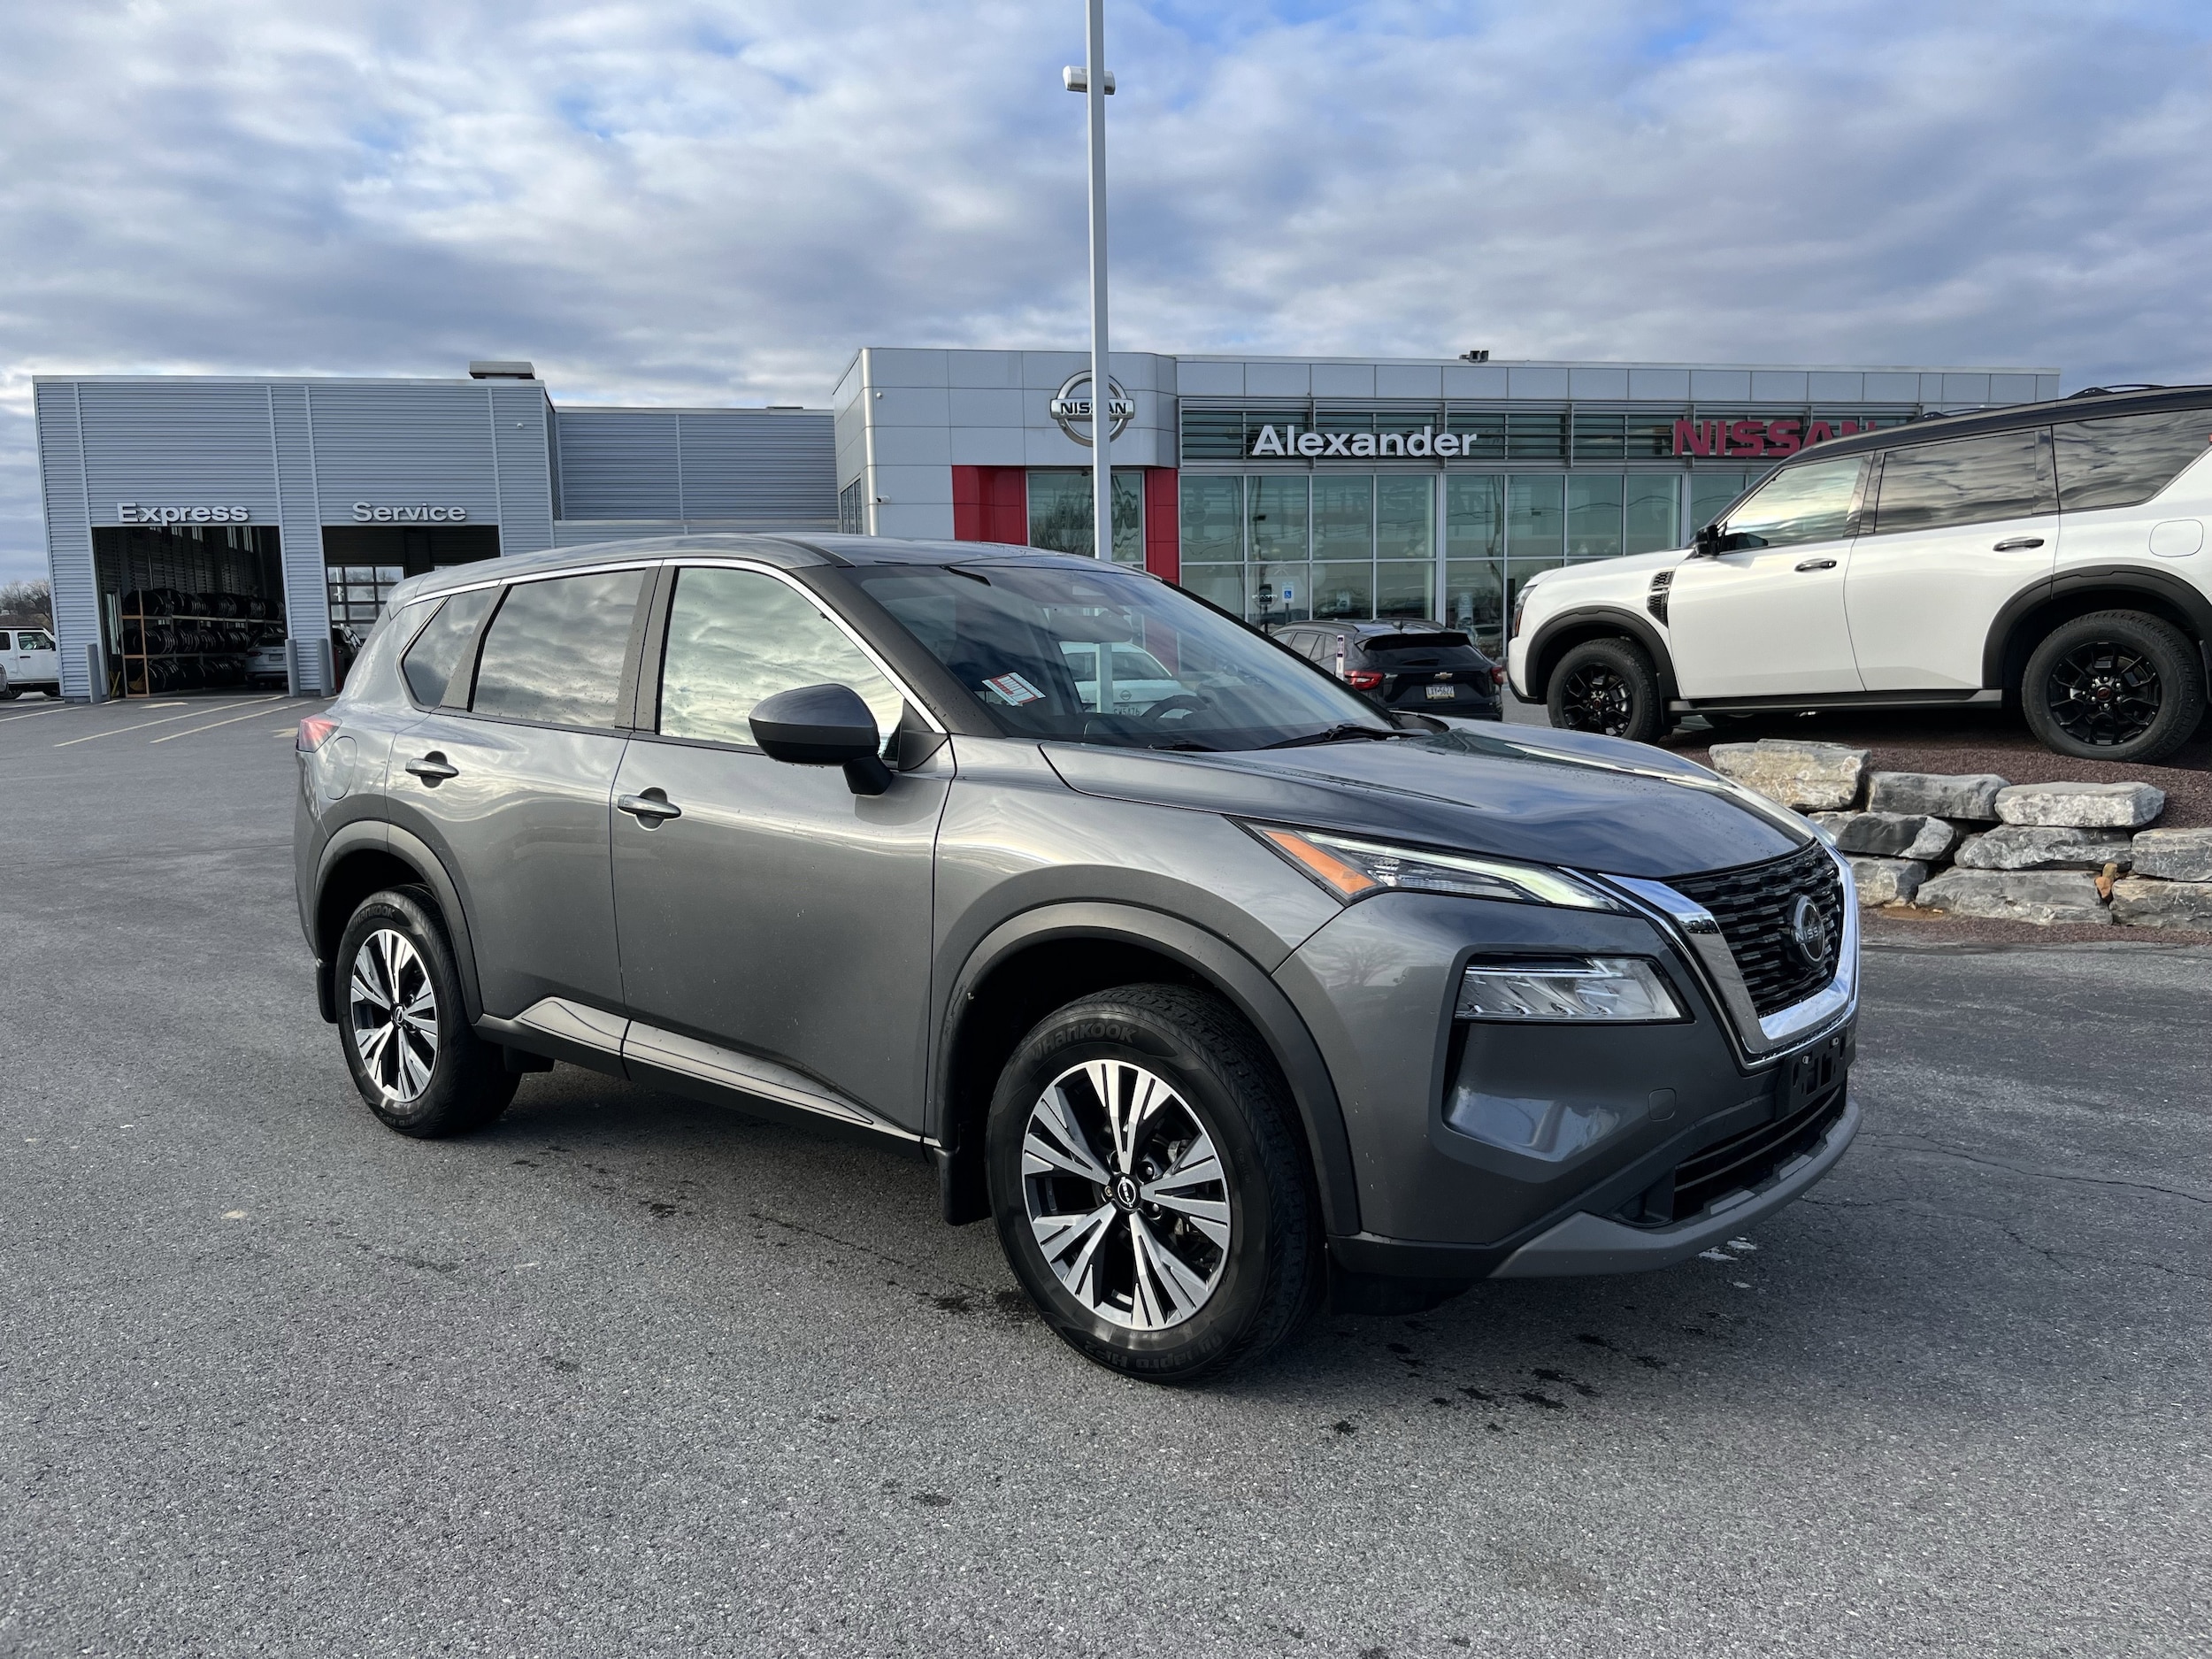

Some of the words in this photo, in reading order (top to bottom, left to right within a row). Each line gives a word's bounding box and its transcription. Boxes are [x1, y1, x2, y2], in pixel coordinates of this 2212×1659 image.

[1061, 402, 1126, 415] NISAN
[1251, 425, 1478, 457] Alexander
[117, 502, 250, 526] Express
[352, 501, 467, 522] Service
